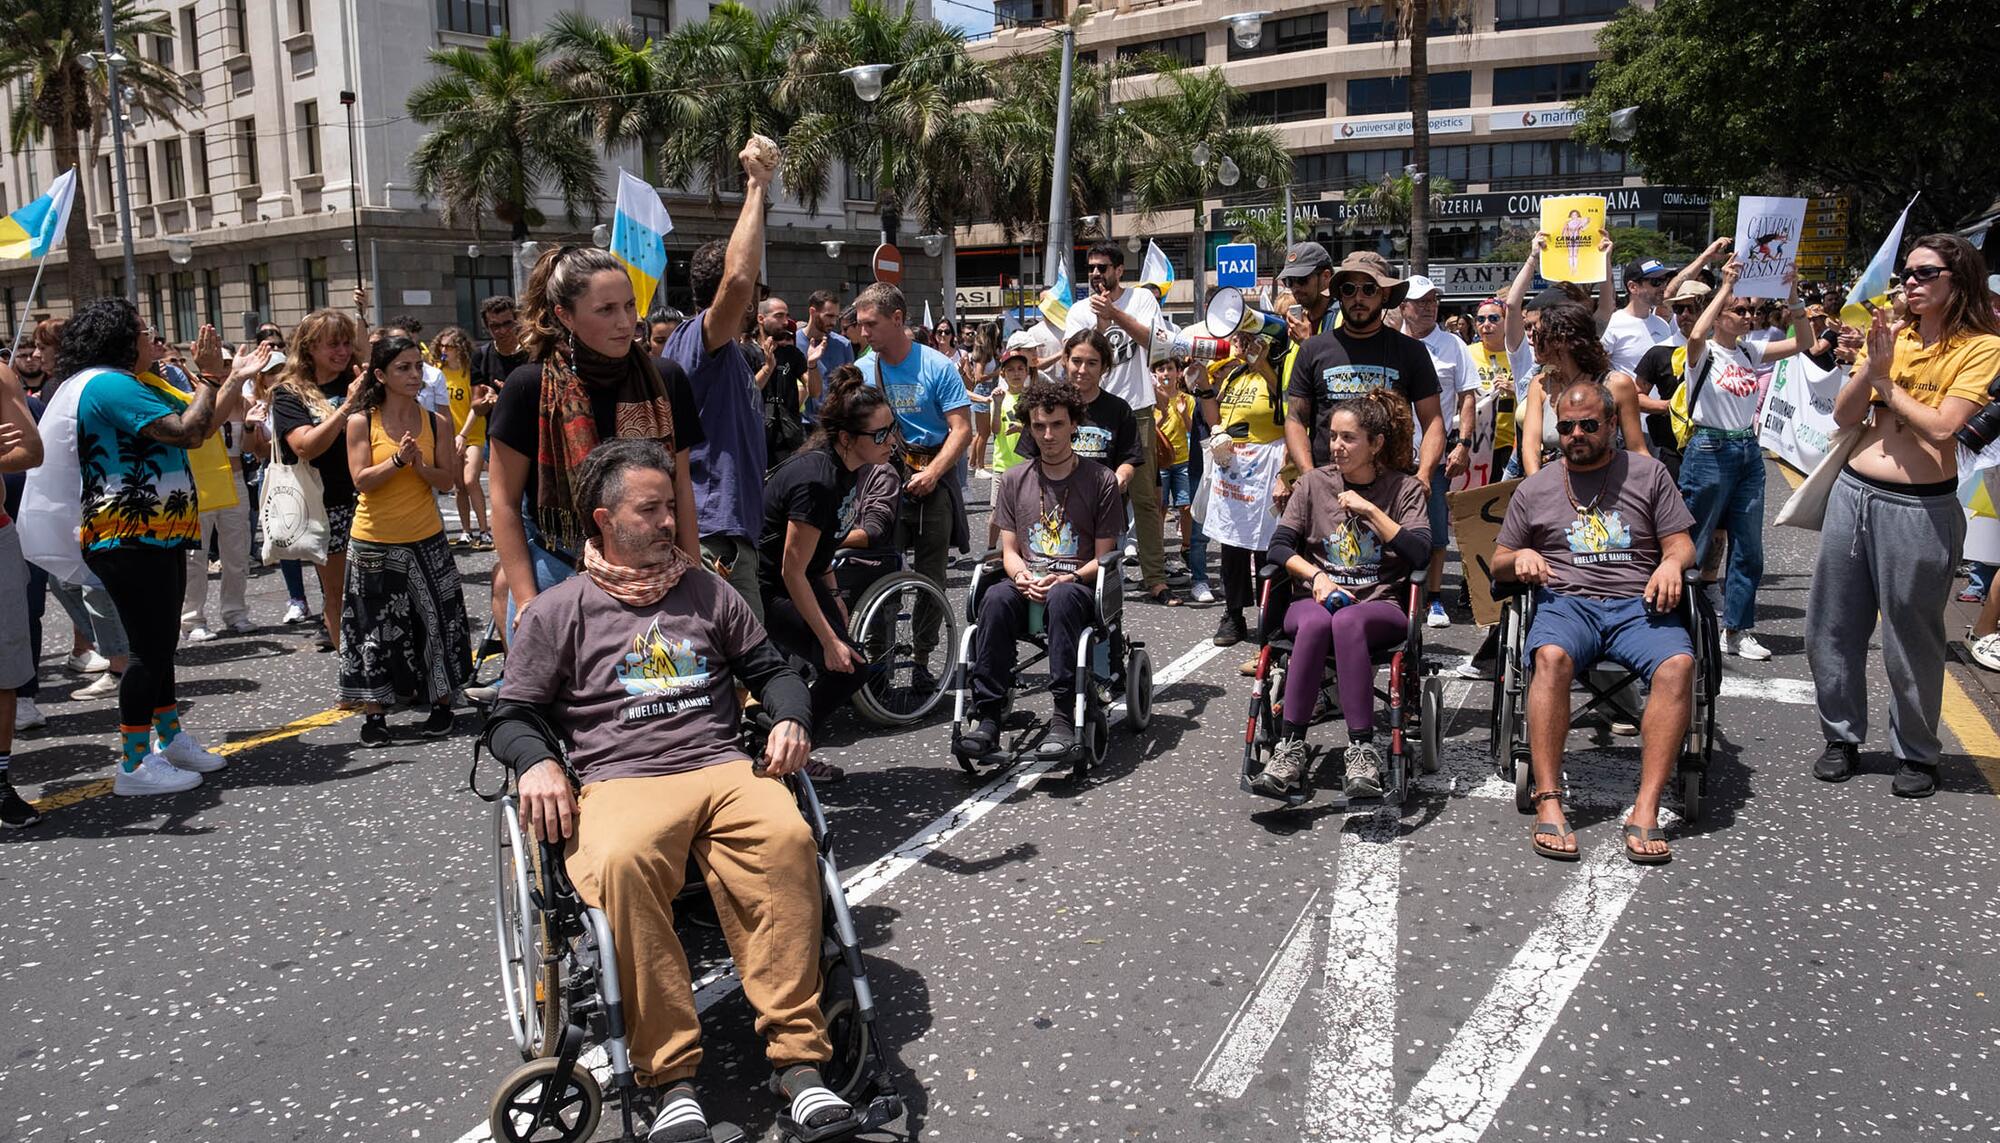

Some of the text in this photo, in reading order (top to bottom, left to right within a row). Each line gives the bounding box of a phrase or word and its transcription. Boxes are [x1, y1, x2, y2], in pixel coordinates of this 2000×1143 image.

[1541, 109, 1585, 122] marme
[1355, 121, 1396, 133] universal
[1428, 117, 1463, 129] ogistics
[1218, 259, 1254, 274] TAXI
[1449, 265, 1518, 284] ANT
[955, 291, 992, 303] ASI
[1573, 552, 1633, 565] HUELGA DE HAMBRE
[628, 695, 712, 719] HUELGA DE HAMBRE
